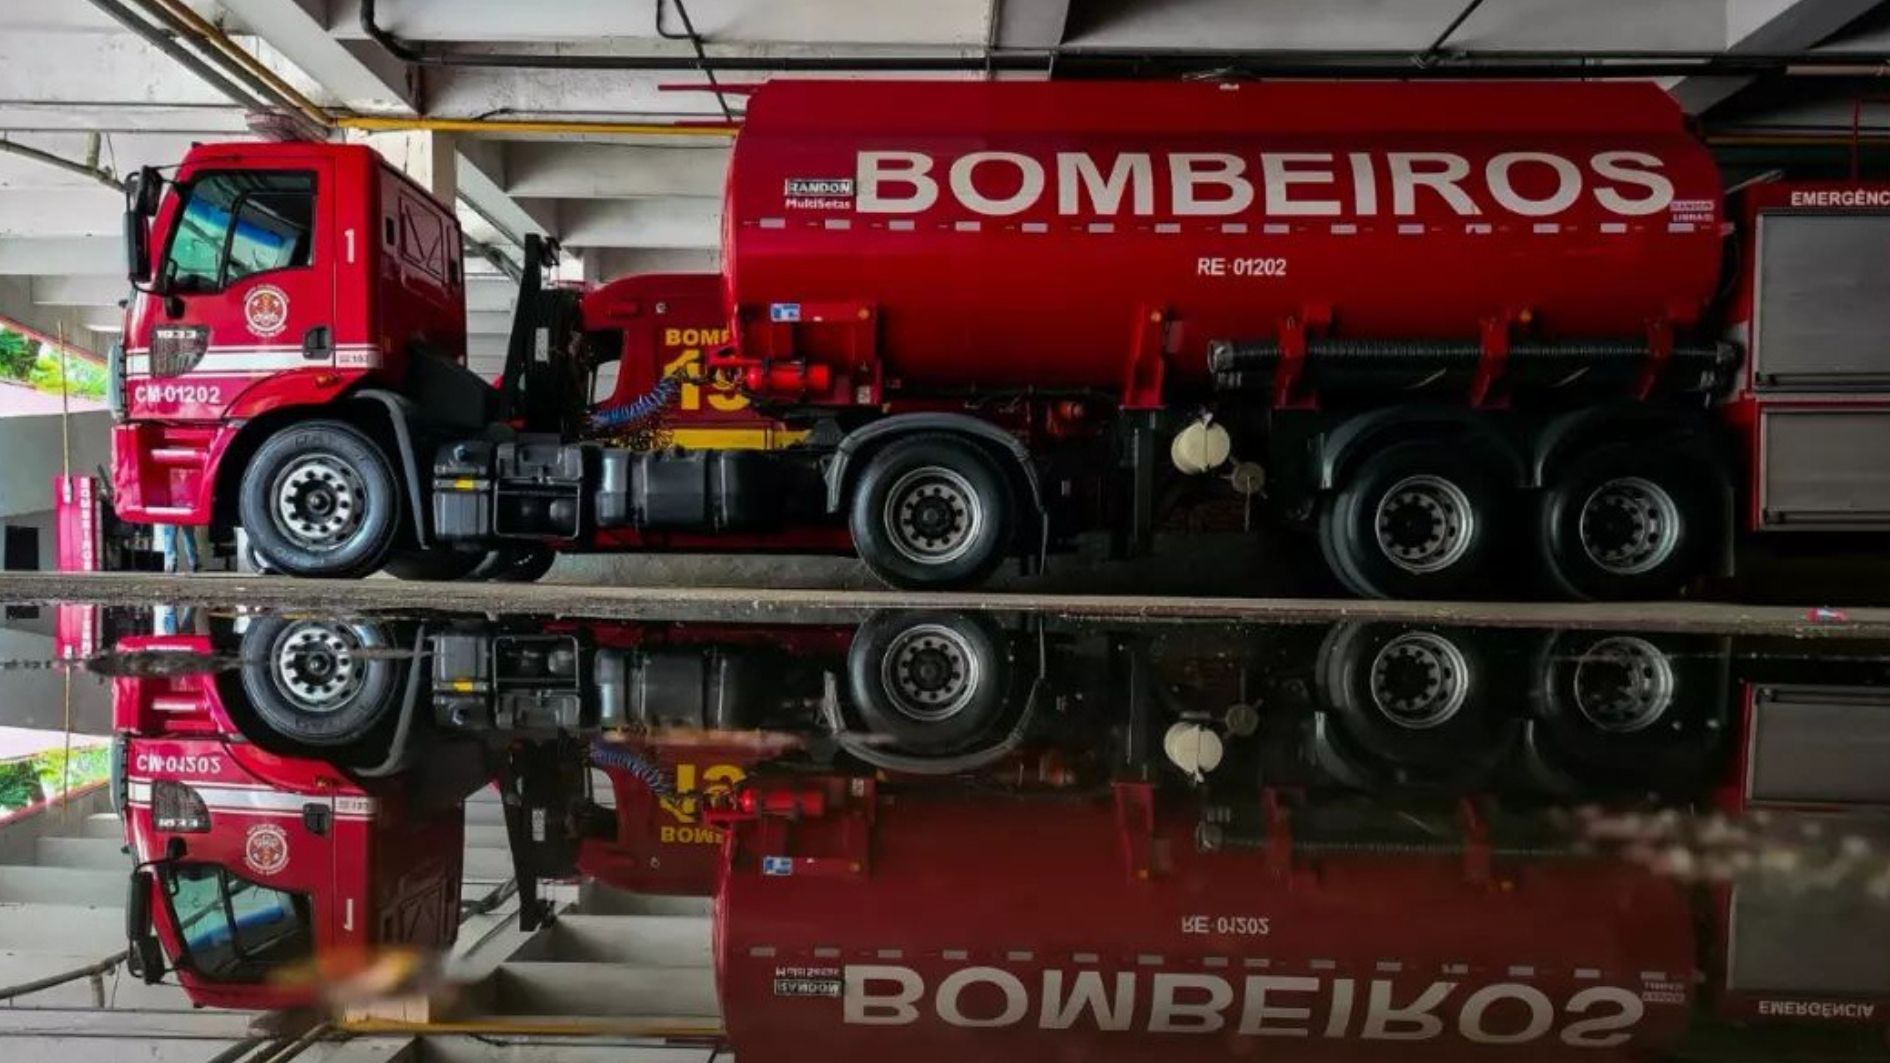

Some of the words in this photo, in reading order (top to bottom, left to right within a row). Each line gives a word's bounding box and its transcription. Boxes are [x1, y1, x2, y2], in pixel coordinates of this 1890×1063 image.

[789, 182, 851, 194] RANDON
[856, 150, 1675, 217] BOMBEIROS
[785, 198, 851, 210] MultiSetas
[344, 228, 355, 263] 1
[135, 385, 221, 405] CM-01202
